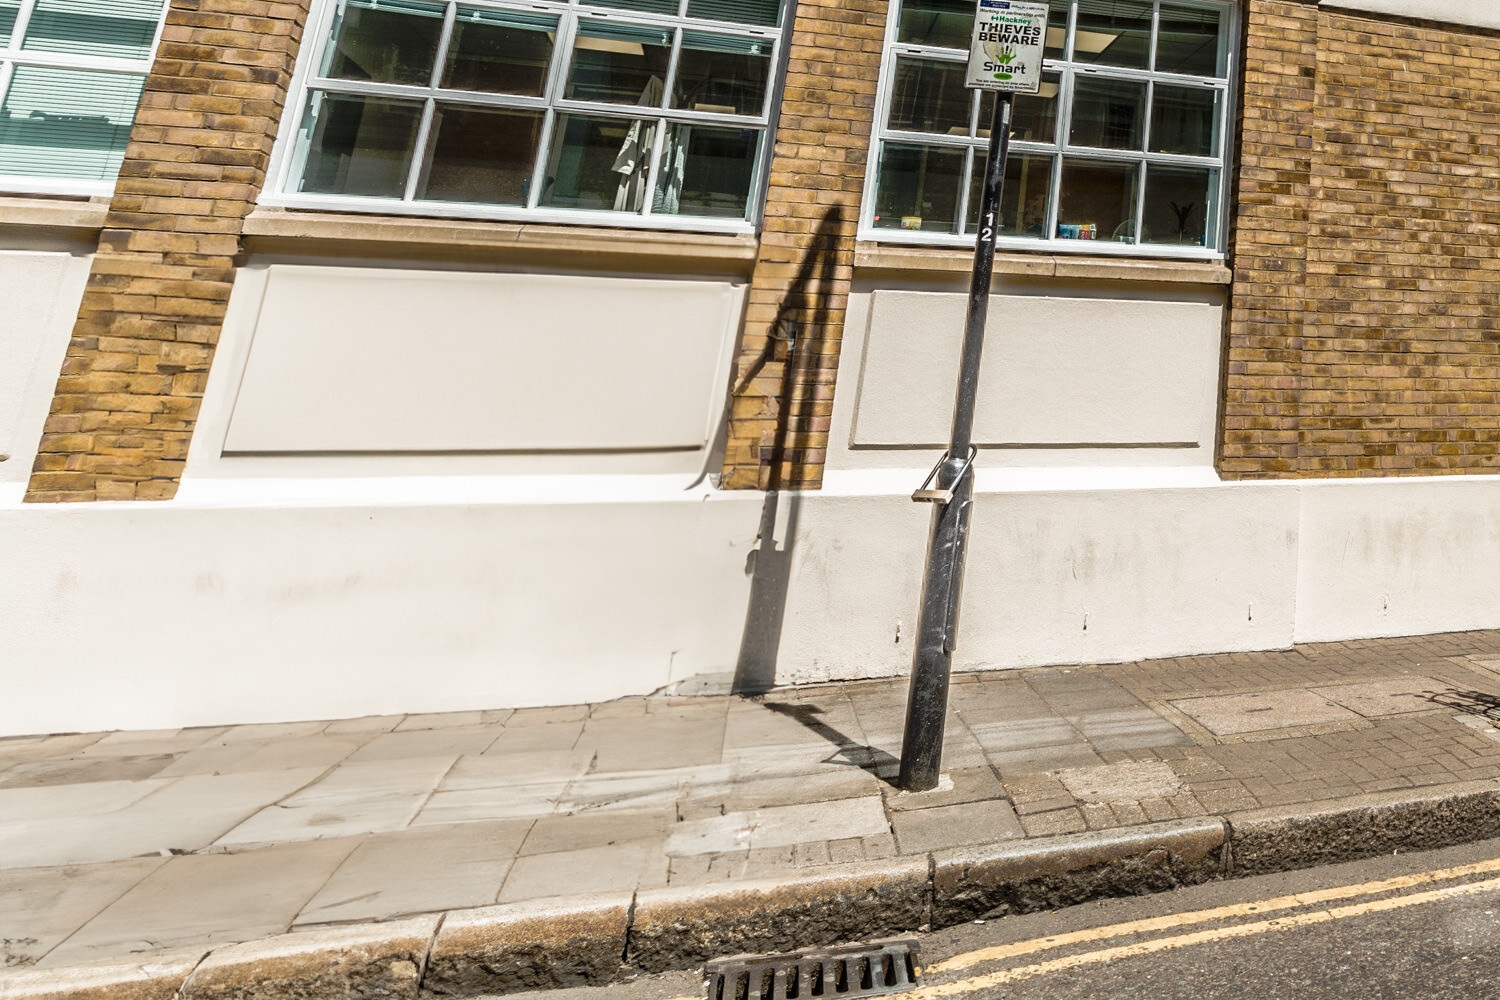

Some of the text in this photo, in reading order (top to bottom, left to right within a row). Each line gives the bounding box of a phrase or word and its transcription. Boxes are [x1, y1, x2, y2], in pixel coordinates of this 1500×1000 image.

[1000, 16, 1032, 25] Hackney
[980, 22, 1041, 36] THIEVES
[978, 32, 1038, 46] BEWARE
[983, 62, 1026, 74] Smart
